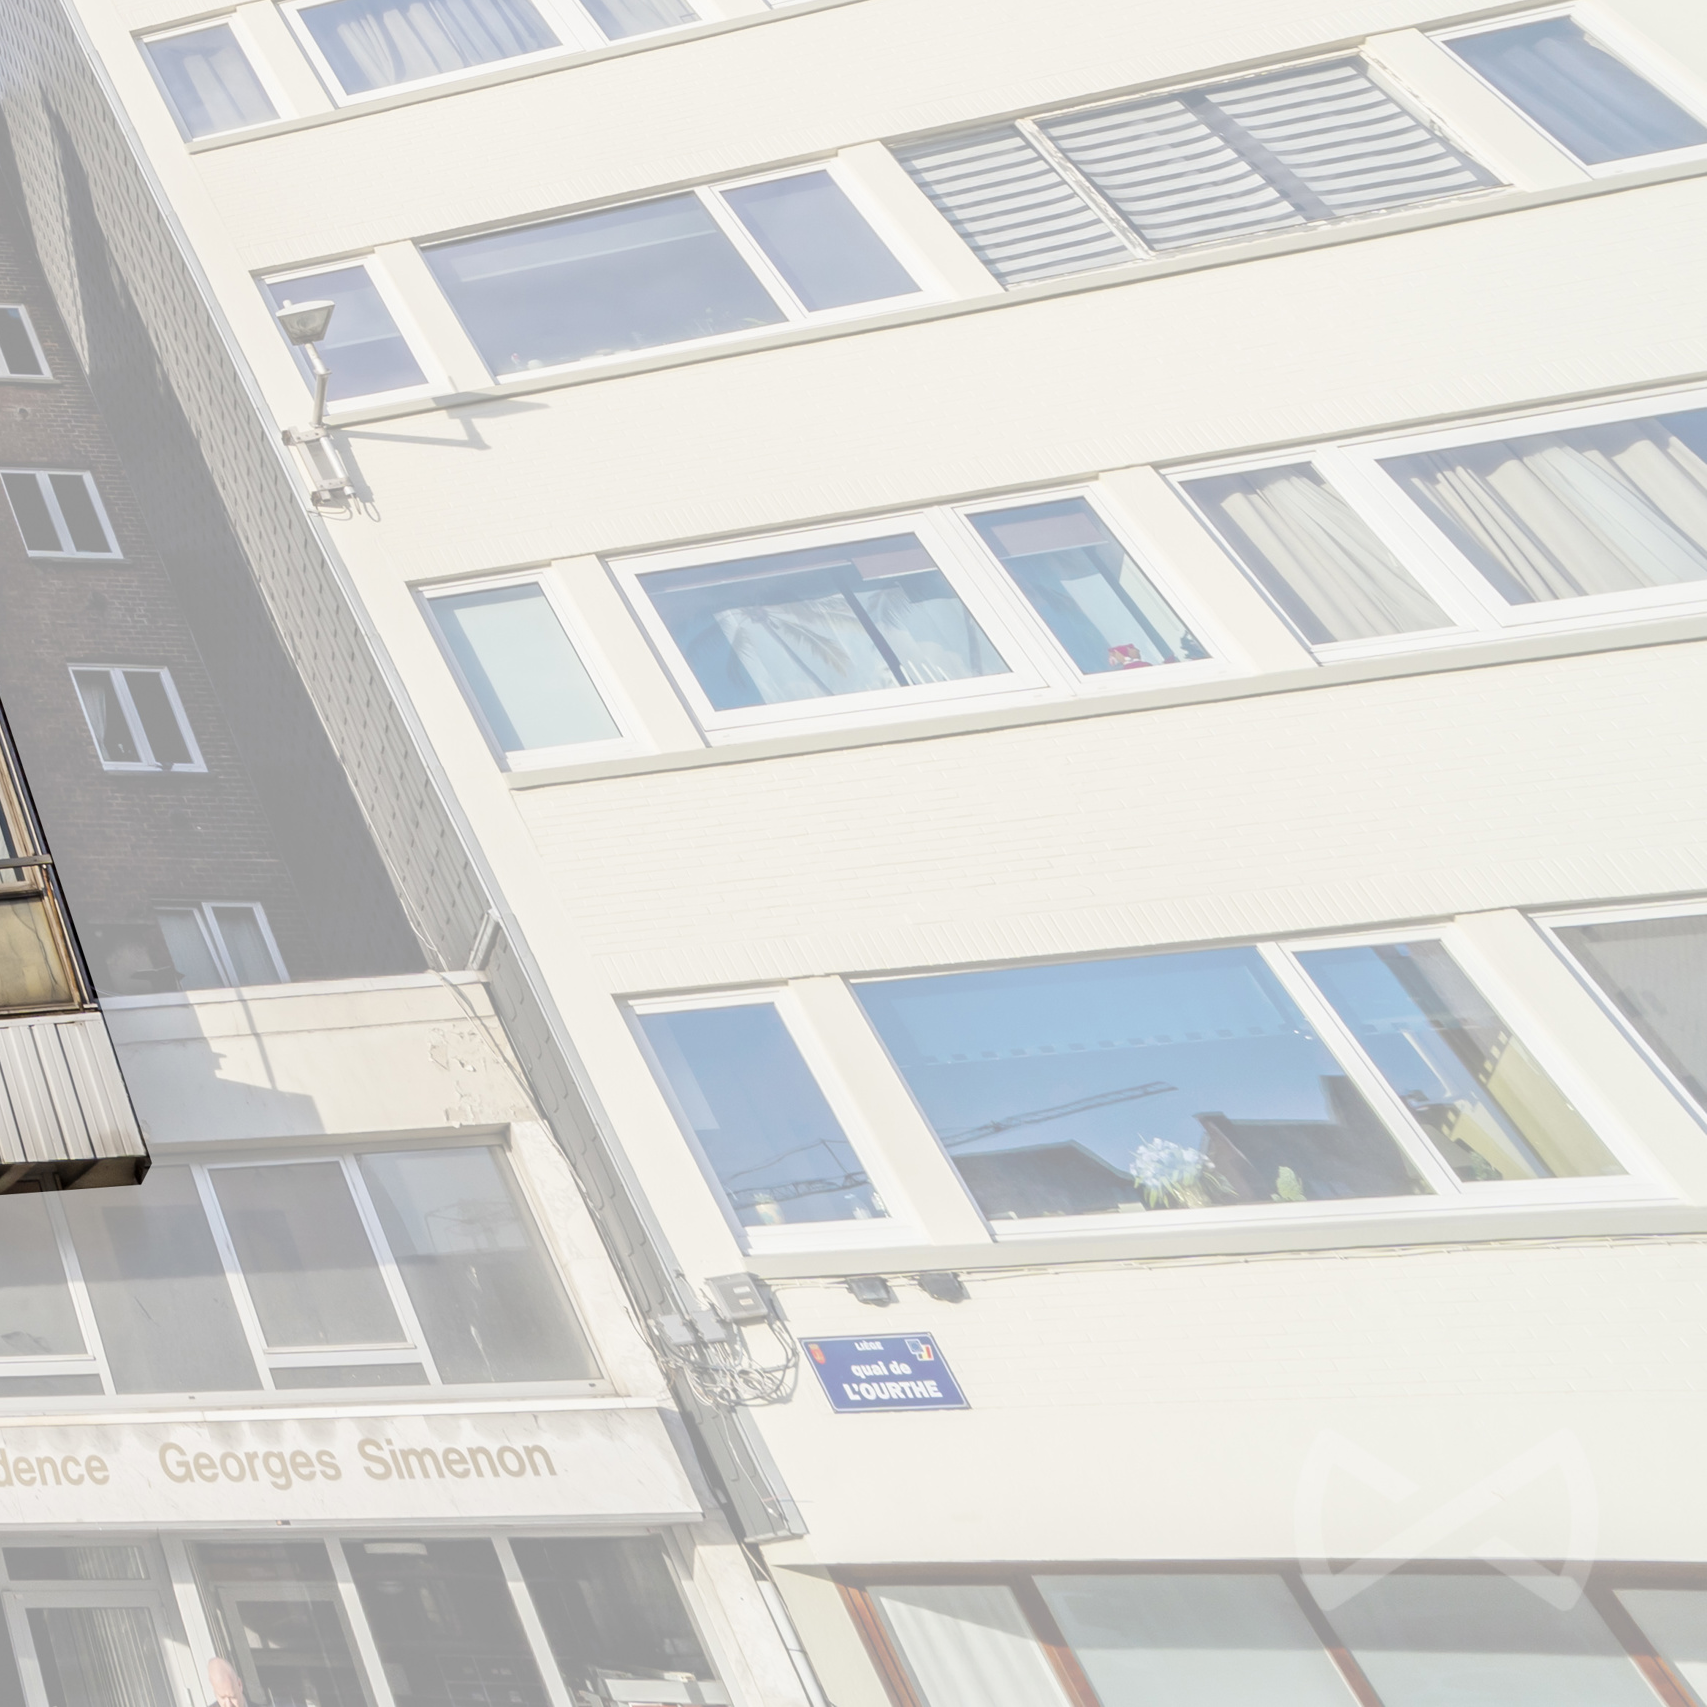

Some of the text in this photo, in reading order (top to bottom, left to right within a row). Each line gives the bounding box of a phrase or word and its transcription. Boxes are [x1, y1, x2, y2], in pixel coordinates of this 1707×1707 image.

[854, 1339, 885, 1352] LIÈGE
[890, 1360, 913, 1375] de
[842, 1380, 944, 1401] L'OURTHE
[158, 1440, 343, 1491] Georges
[356, 1437, 557, 1483] Simenon
